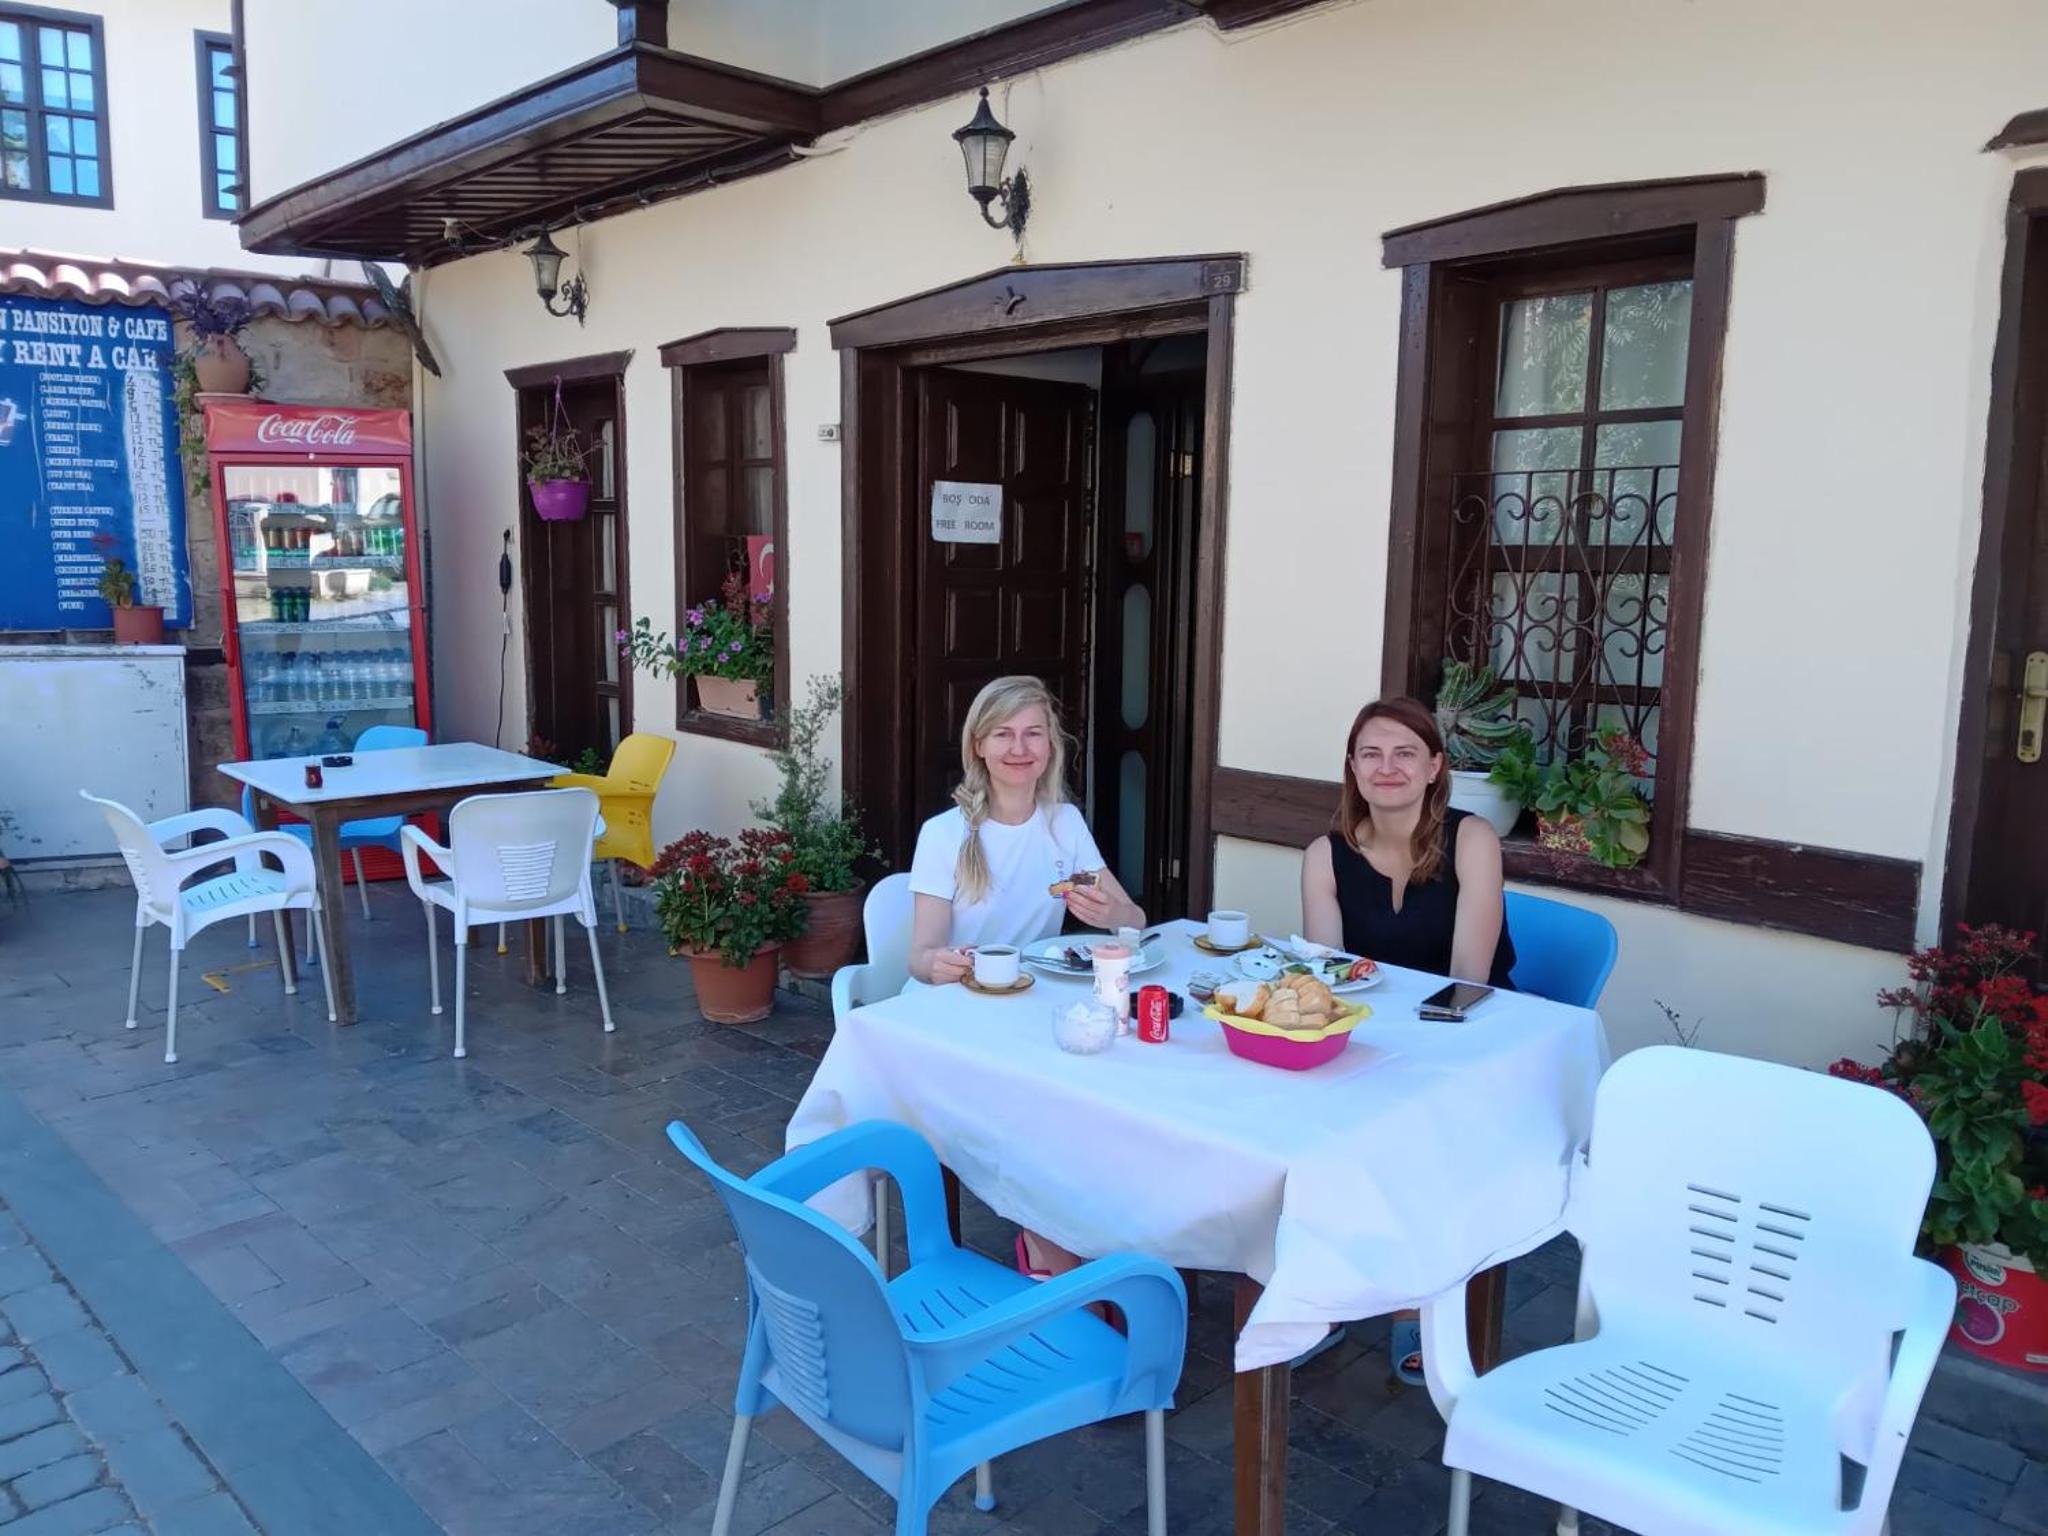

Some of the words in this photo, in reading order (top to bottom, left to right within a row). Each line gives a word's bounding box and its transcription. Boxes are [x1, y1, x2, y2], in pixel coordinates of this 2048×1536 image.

[12, 307, 103, 337] PANSİYON
[108, 316, 120, 338] &
[125, 317, 168, 341] CAFE
[14, 340, 82, 367] RENT
[87, 345, 107, 369] A
[112, 347, 159, 371] CAR
[258, 413, 359, 444] Coca-Cola
[969, 495, 991, 506] ODA
[936, 519, 956, 530] FREE
[964, 521, 995, 531] ROOM
